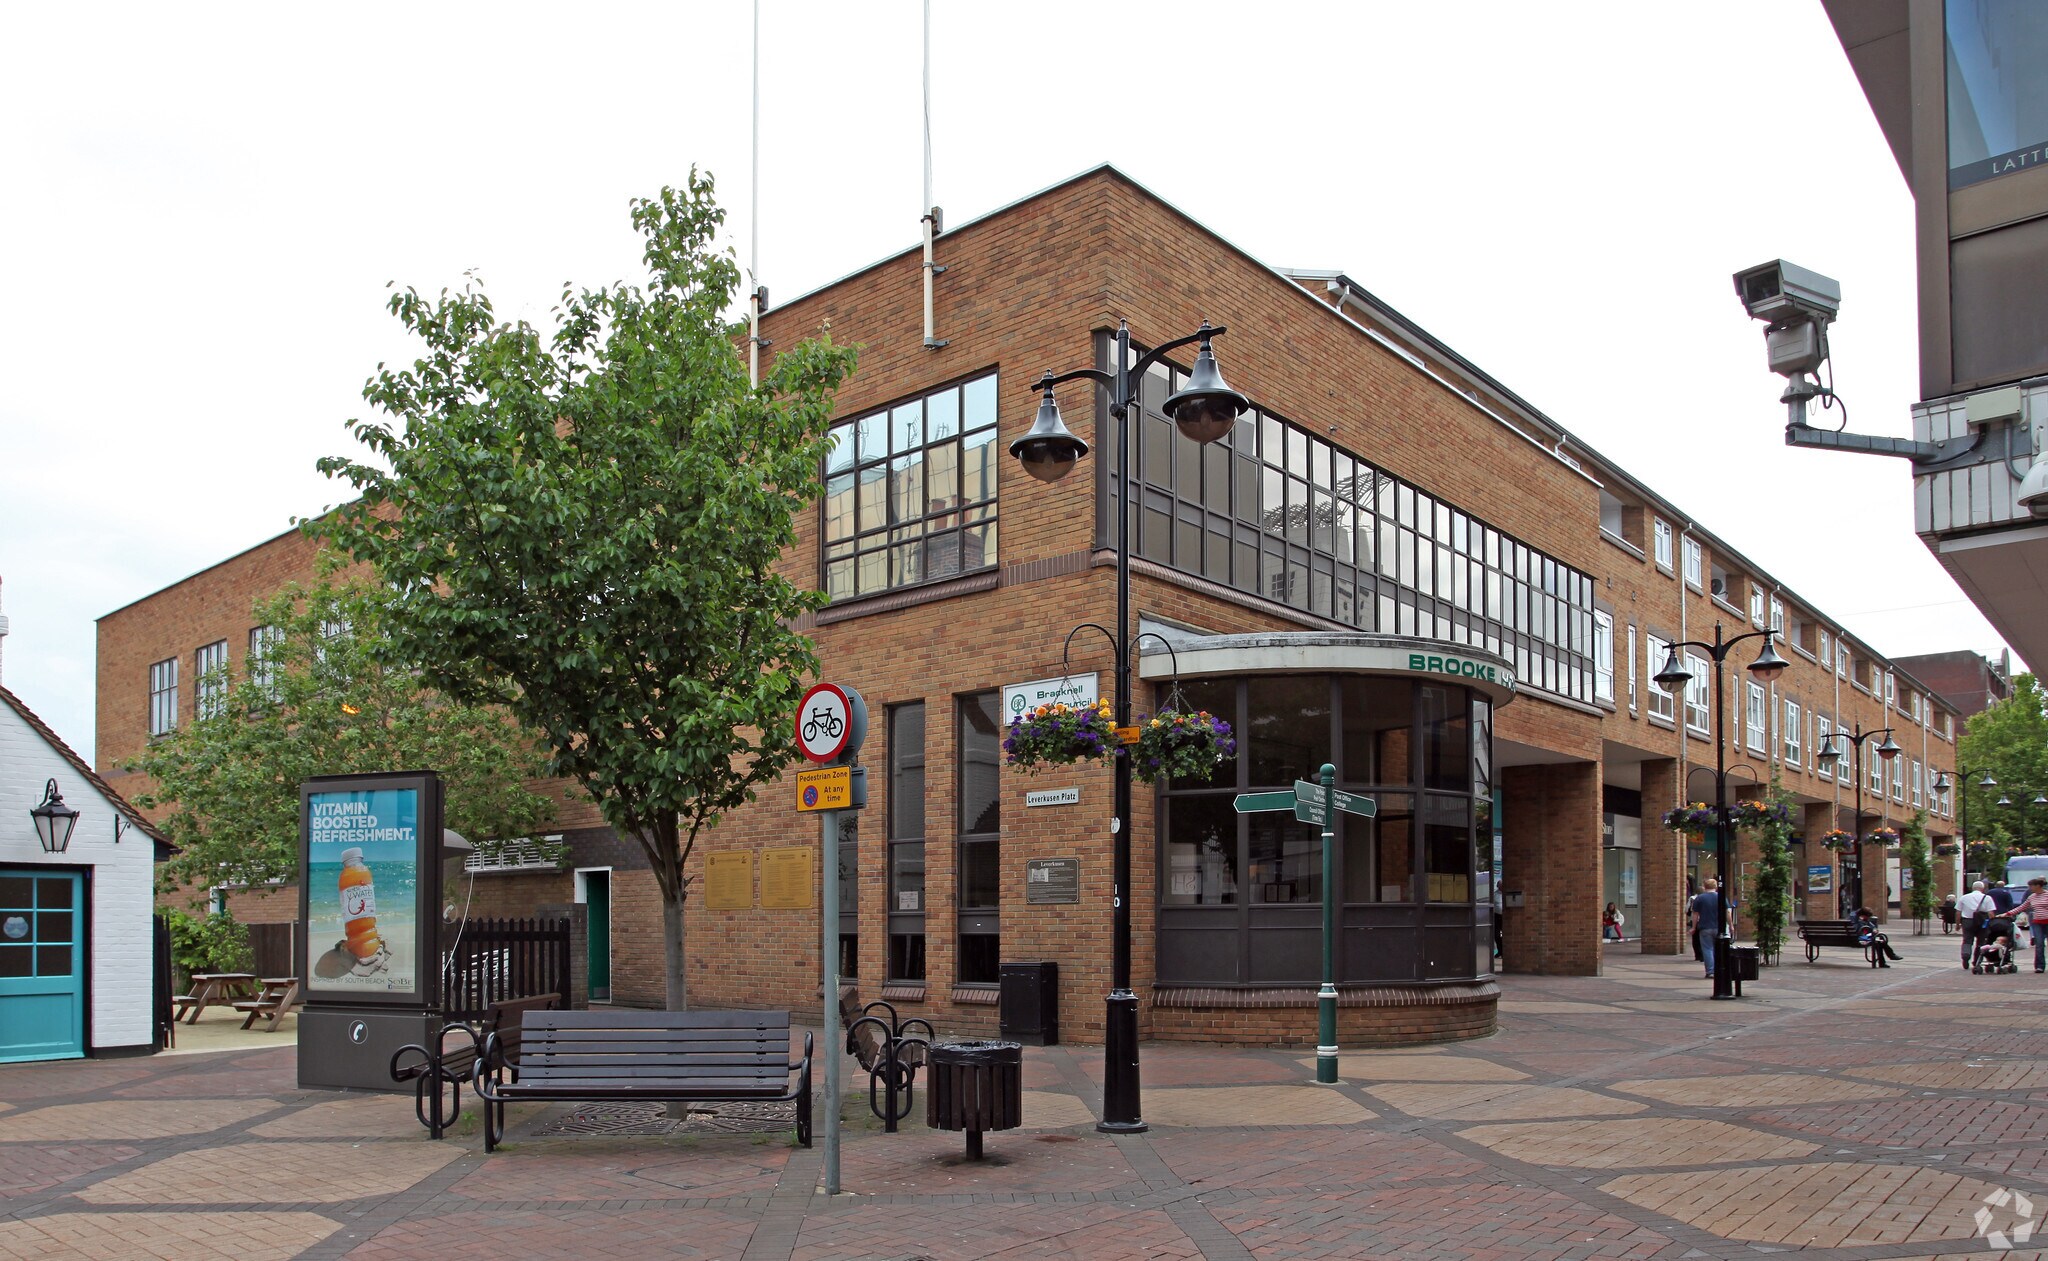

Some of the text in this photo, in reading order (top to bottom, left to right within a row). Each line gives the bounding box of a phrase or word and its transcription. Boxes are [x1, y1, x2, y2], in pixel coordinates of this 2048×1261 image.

[1409, 654, 1495, 682] BROOKE
[1036, 685, 1083, 700] Bracknell
[800, 771, 848, 782] Pedestrian Zone
[827, 794, 841, 802] time
[1028, 792, 1076, 803] Leverkusen Platz
[313, 802, 368, 816] VITAMIN
[313, 815, 378, 829] BOOSTED
[312, 828, 415, 843] REFRESHMENT.
